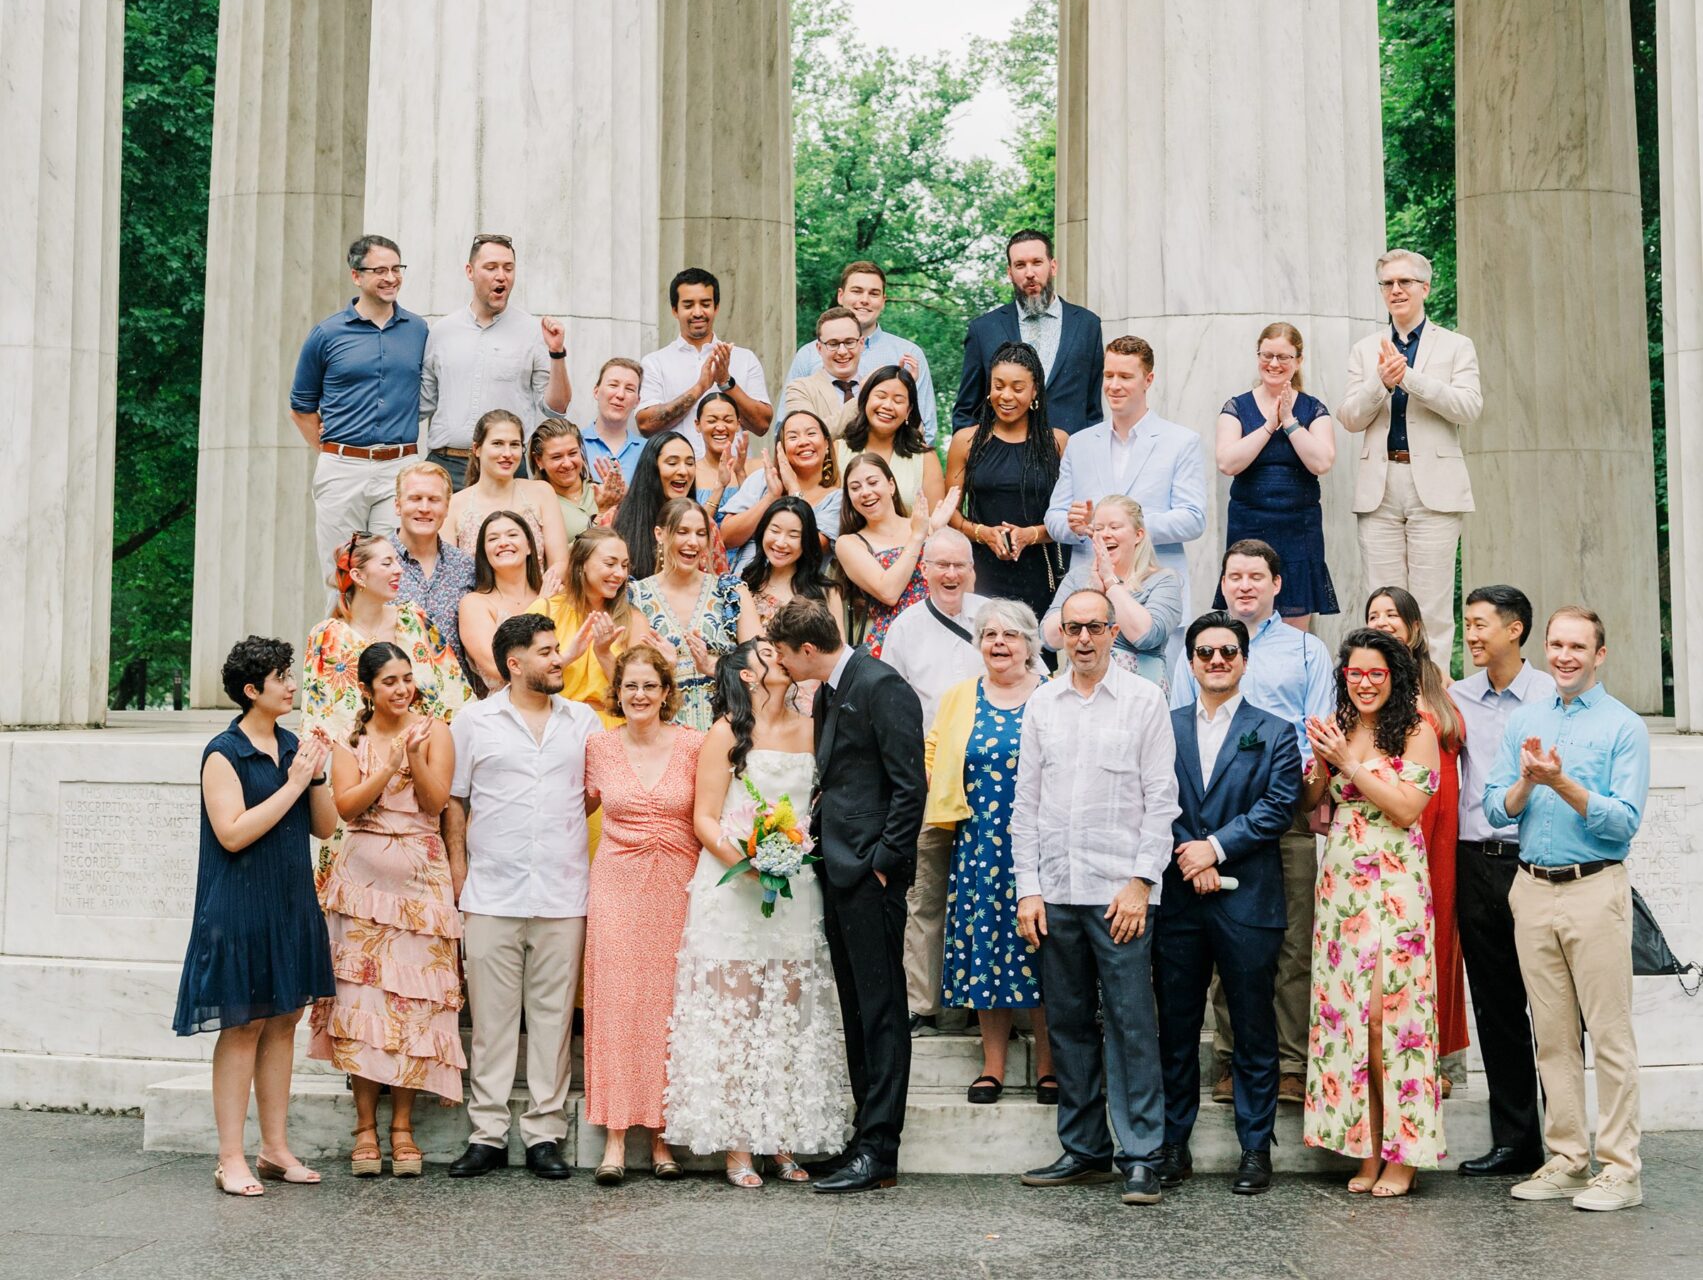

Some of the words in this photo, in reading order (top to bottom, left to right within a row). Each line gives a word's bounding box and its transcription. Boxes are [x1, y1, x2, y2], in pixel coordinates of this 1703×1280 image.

[65, 800, 141, 814] SUBSCRIPTIONS
[147, 802, 160, 815] OF
[65, 814, 121, 827] DEDICATED
[65, 827, 137, 842] THIRTY-ONE
[147, 829, 161, 843] BY
[64, 841, 84, 855] THE
[90, 842, 124, 856] UNITED
[130, 843, 168, 857] STATES
[1631, 840, 1680, 854] ERVICE
[64, 855, 121, 869] RECORDED
[128, 857, 148, 870] THE
[64, 869, 157, 884] WASHINGTONIANS
[164, 872, 190, 886] WHO
[64, 882, 81, 896] THE
[87, 883, 121, 897] WORLD
[126, 885, 149, 898] WAR
[63, 896, 73, 909] IN
[77, 897, 96, 910] THE
[102, 899, 131, 911] ARMY
